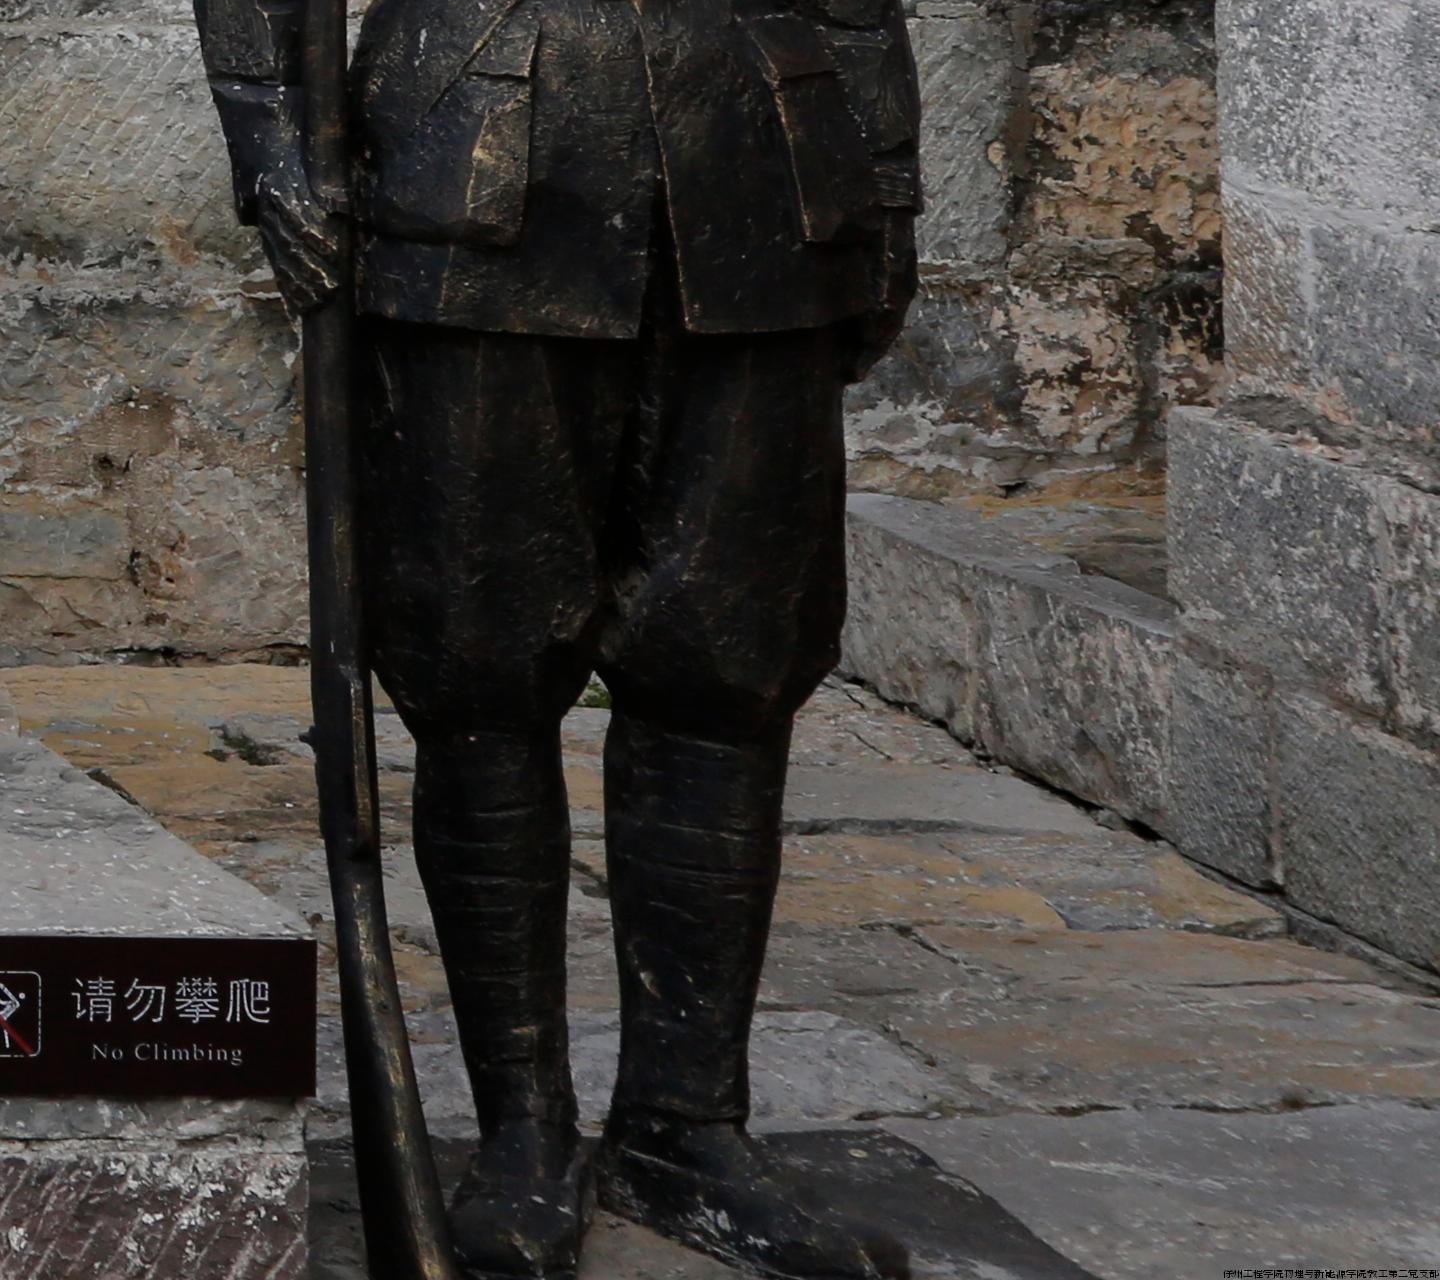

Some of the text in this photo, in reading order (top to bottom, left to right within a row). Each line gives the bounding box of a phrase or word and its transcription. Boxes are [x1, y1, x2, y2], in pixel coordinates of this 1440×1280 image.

[71, 976, 271, 1024] 请勿攀爬
[92, 1042, 243, 1067] No Climbing
